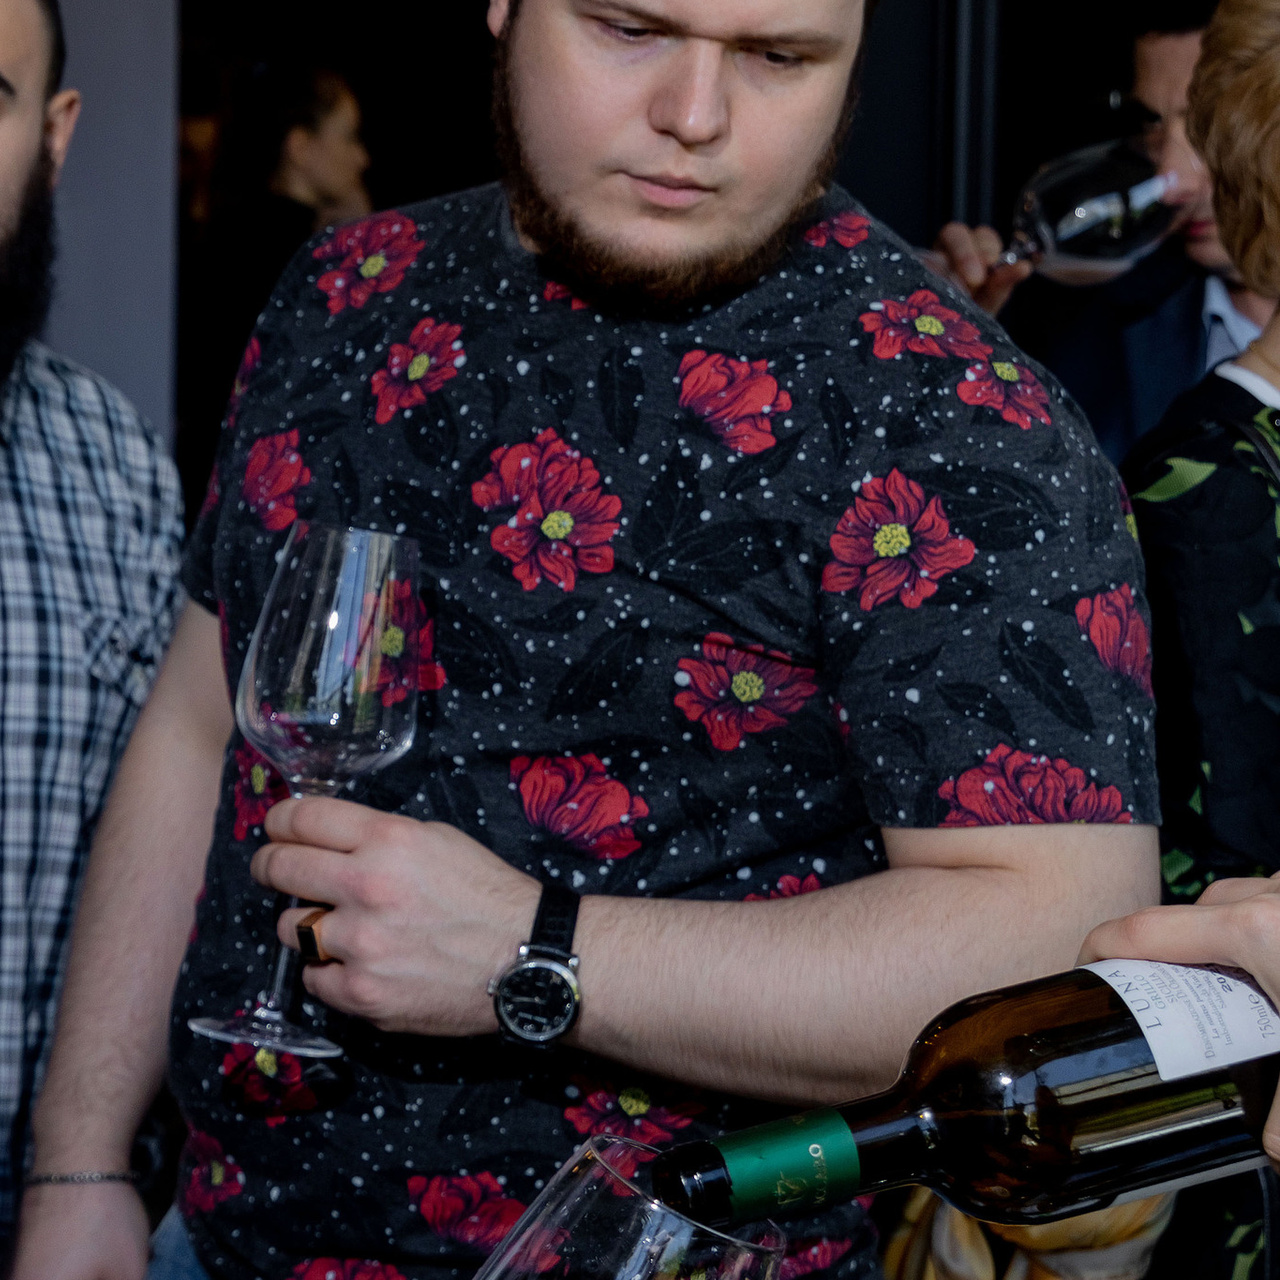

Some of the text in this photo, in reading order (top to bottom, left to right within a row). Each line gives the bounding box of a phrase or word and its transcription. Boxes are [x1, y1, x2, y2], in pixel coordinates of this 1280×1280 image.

[1108, 970, 1162, 1029] LUNA
[1134, 974, 1166, 1010] GRILLO
[1149, 973, 1178, 1003] SICILIA
